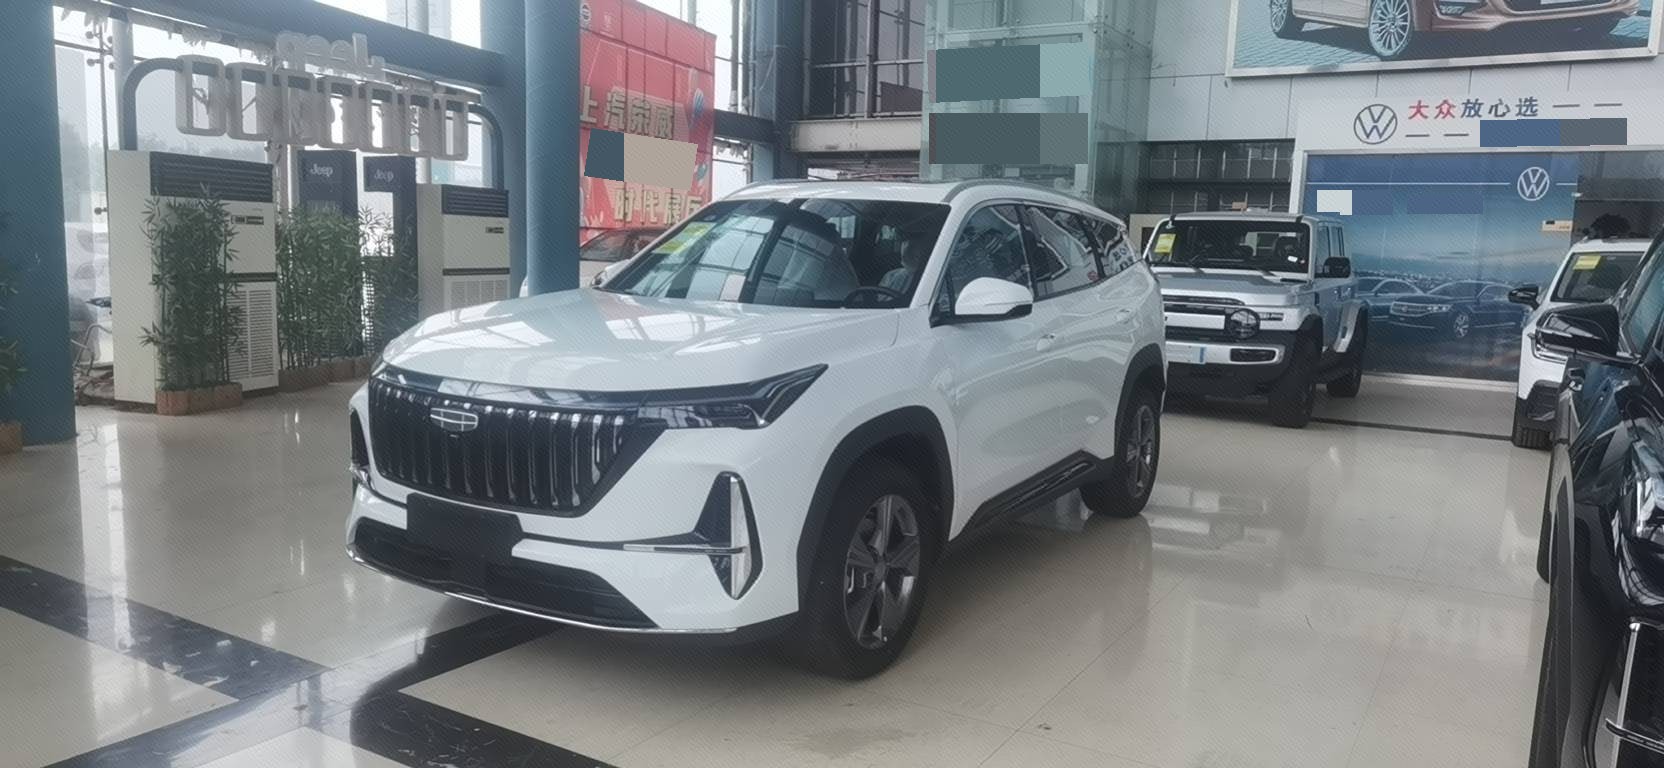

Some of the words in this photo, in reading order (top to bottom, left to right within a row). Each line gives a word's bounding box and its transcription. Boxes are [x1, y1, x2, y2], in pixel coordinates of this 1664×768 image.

[580, 85, 674, 140] 上汽荣威
[1407, 97, 1539, 120] 大众放心选
[310, 163, 333, 177] Jeep
